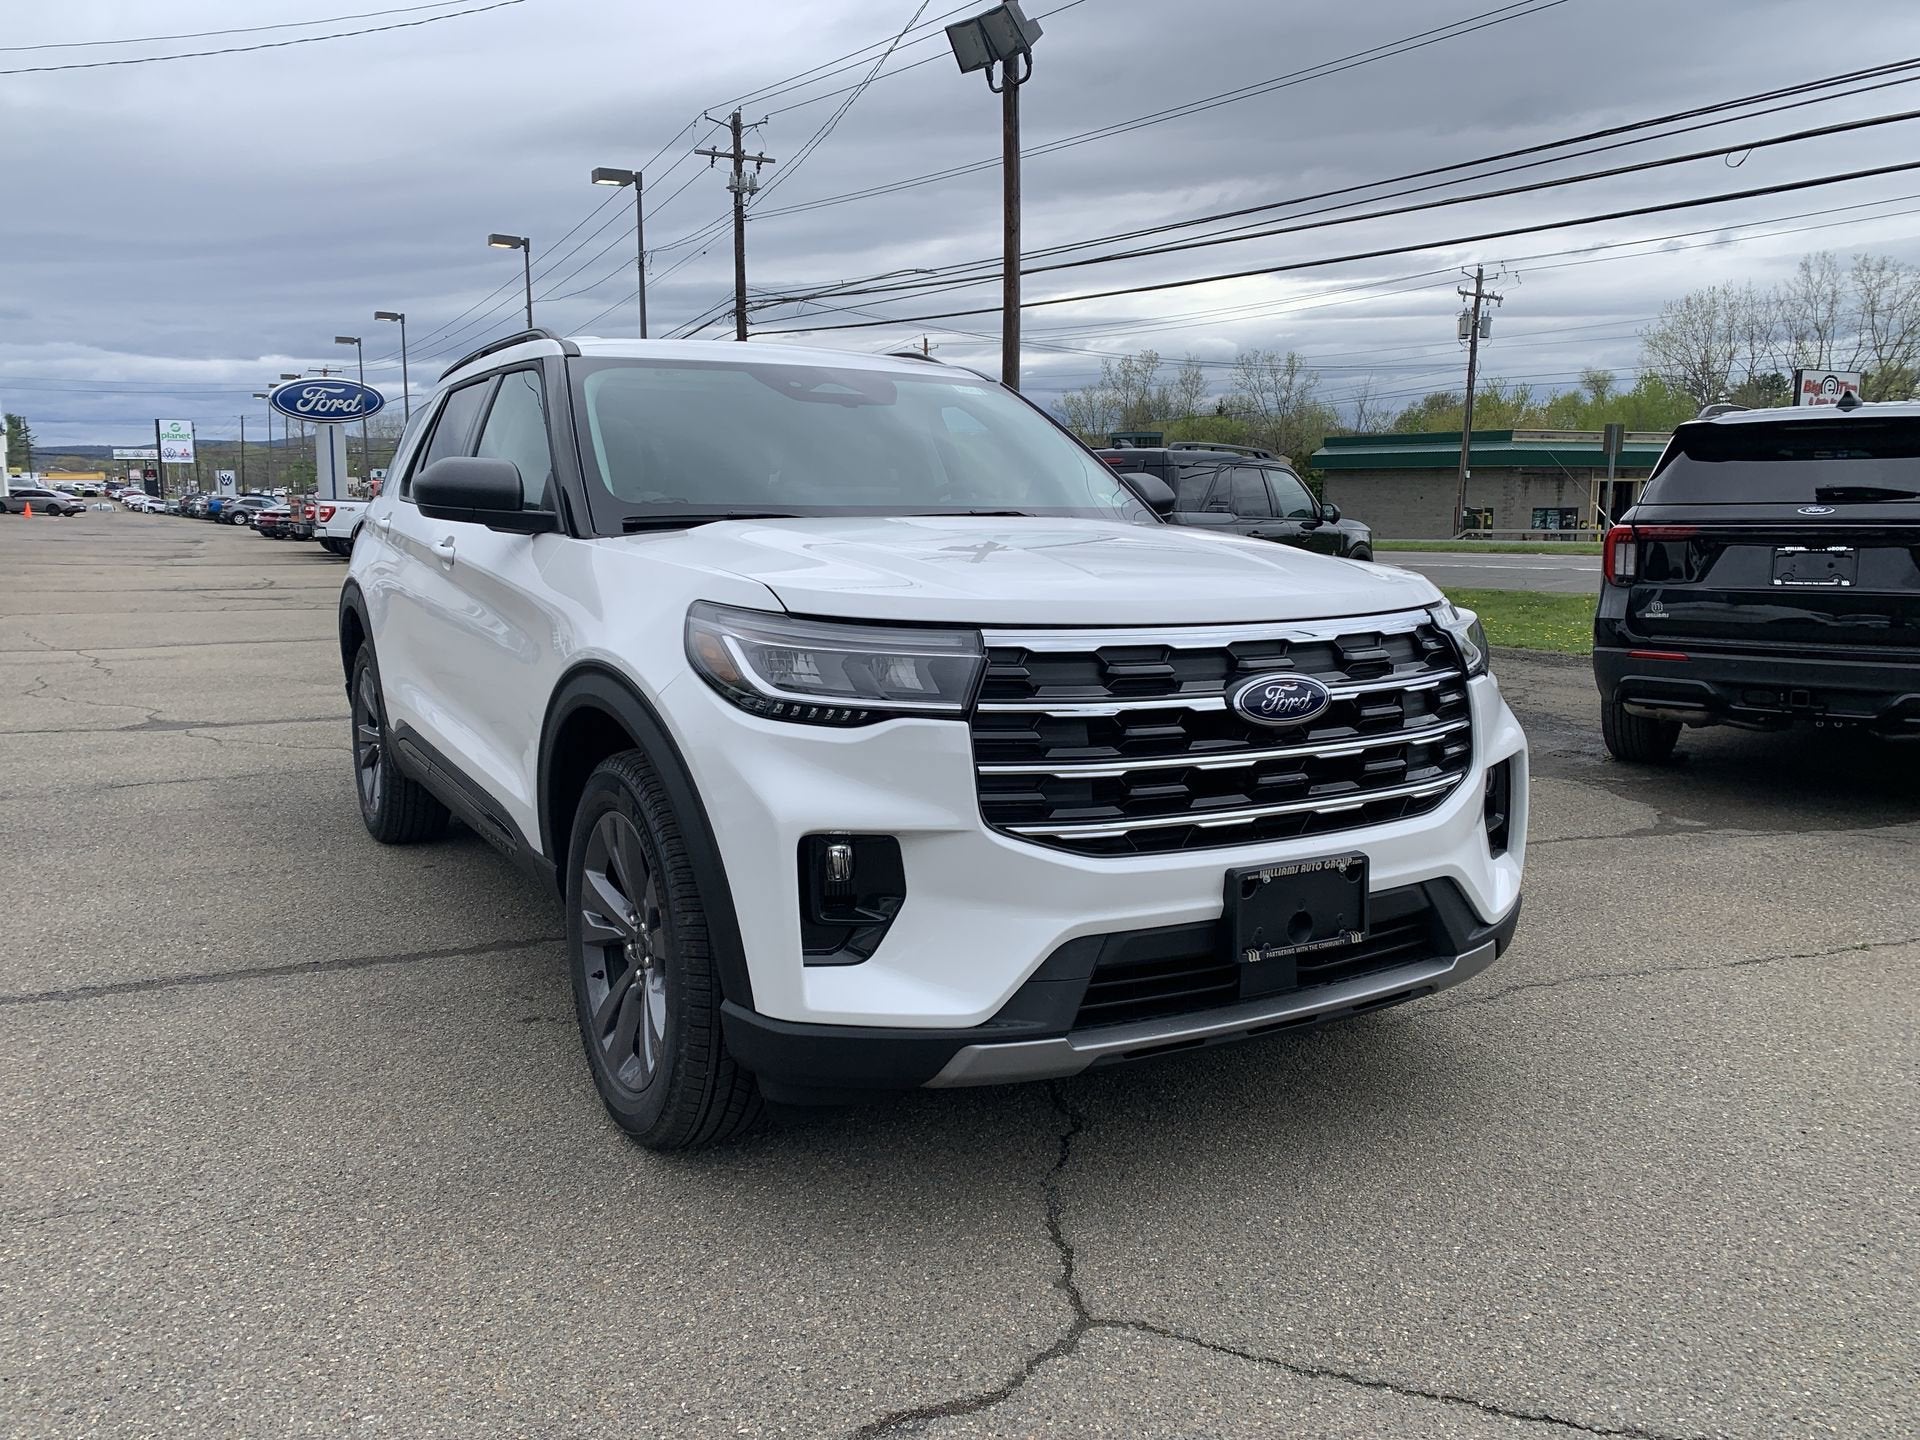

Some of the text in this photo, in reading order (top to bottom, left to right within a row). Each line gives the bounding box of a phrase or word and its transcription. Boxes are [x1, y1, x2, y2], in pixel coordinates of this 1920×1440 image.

[296, 386, 363, 412] Ford
[161, 432, 191, 440] planet
[1261, 685, 1312, 712] Ford
[1300, 862, 1322, 873] AUTO
[1296, 945, 1308, 953] WITH
[1309, 943, 1318, 951] THE
[1318, 939, 1346, 949] COMMUNITY
